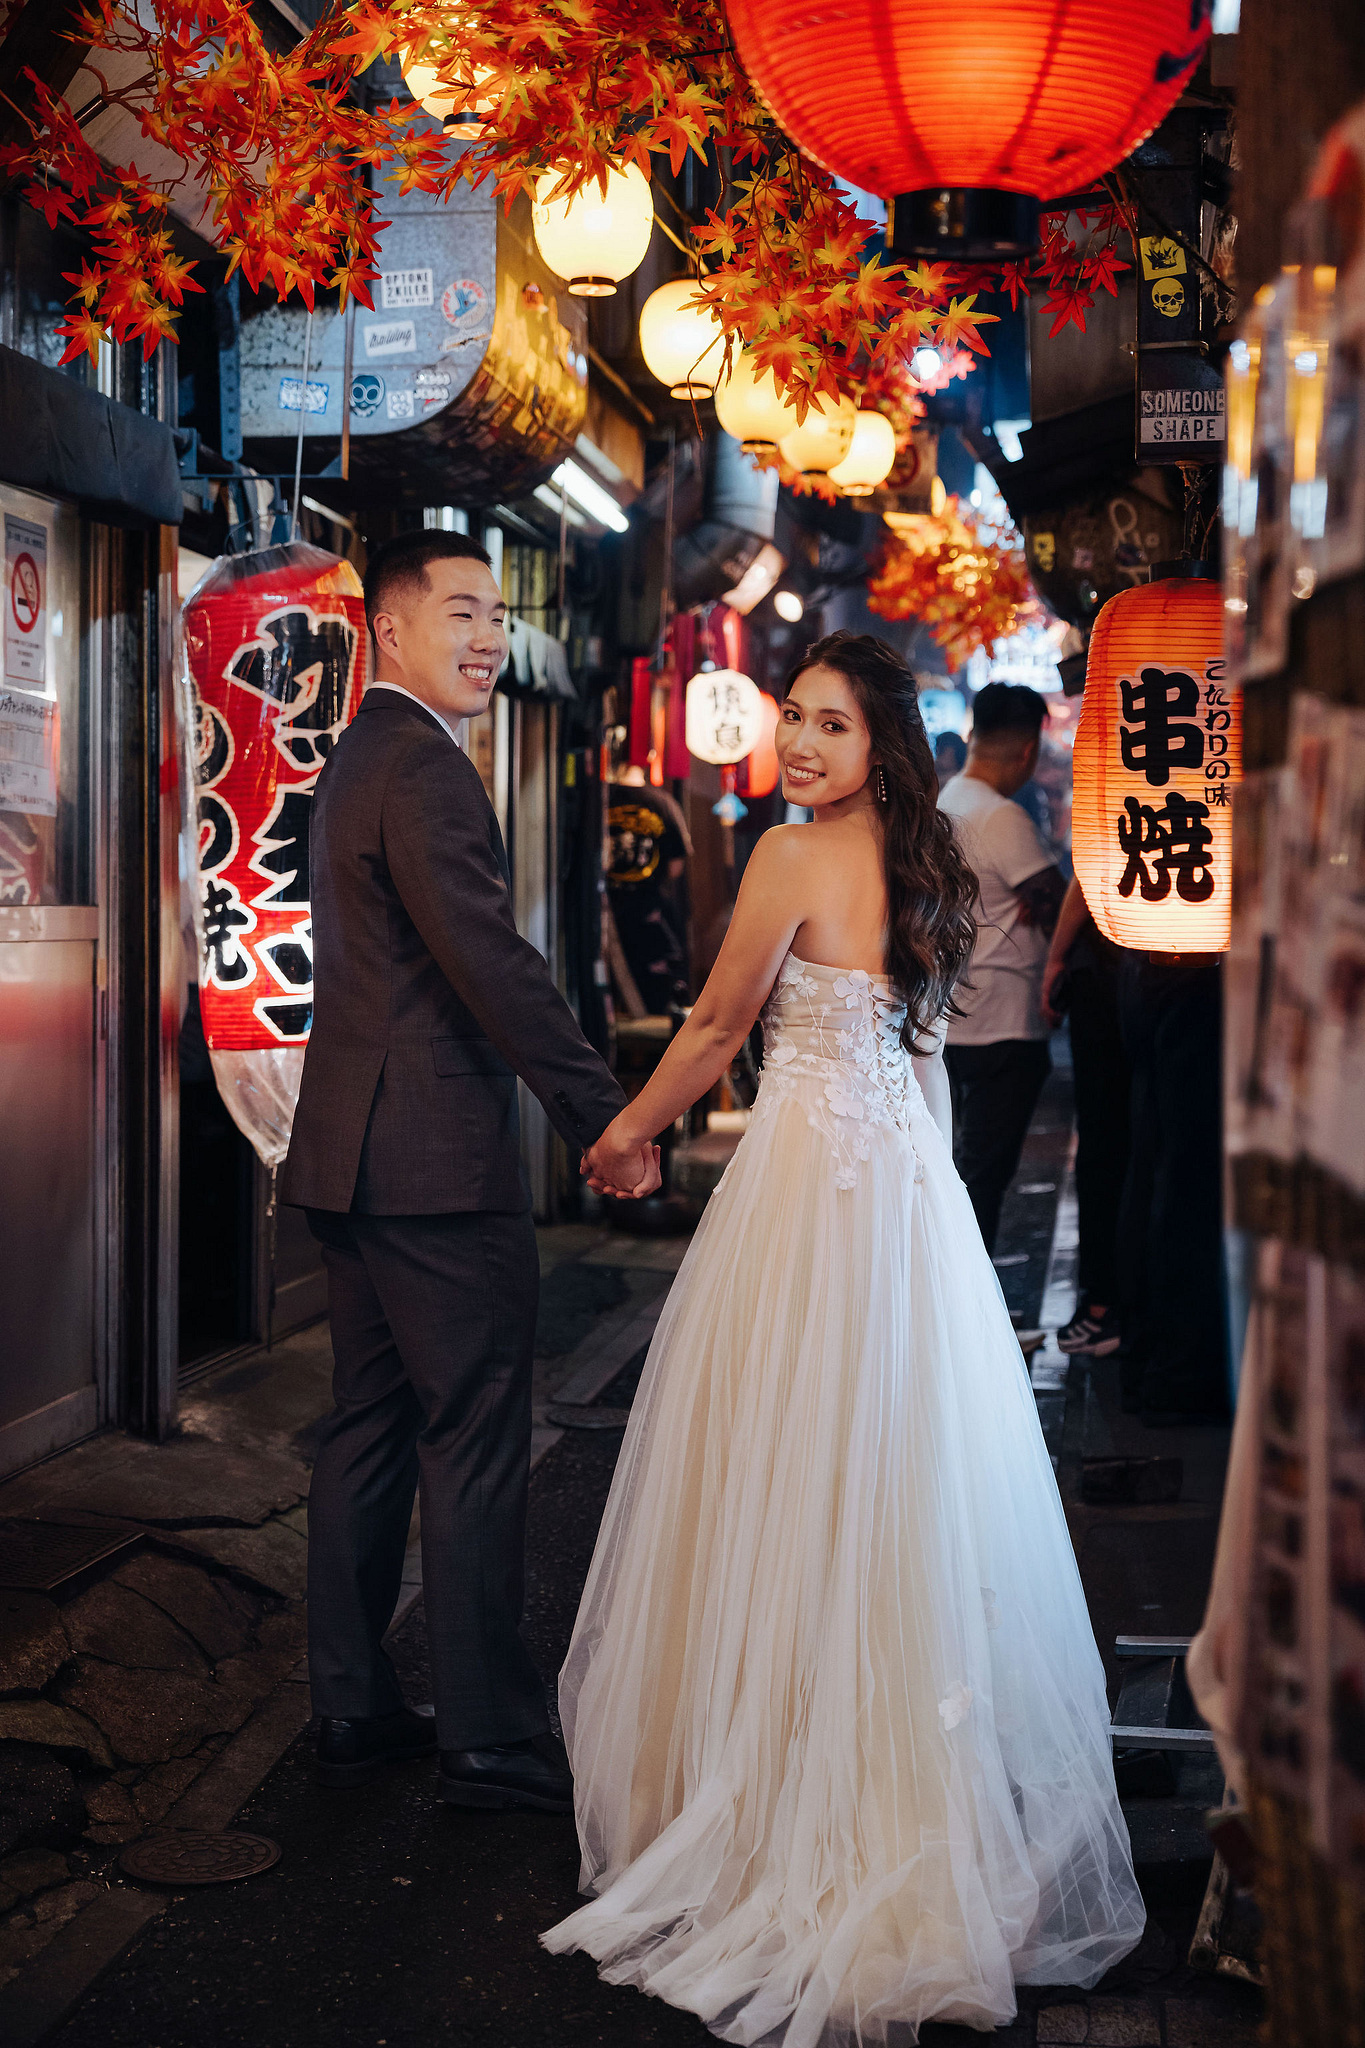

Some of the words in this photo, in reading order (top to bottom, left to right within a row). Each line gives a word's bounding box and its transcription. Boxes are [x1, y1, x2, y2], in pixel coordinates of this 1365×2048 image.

[1142, 390, 1225, 414] SOMEONE
[1153, 418, 1216, 441] SHAPE
[1117, 667, 1215, 903] 串焼
